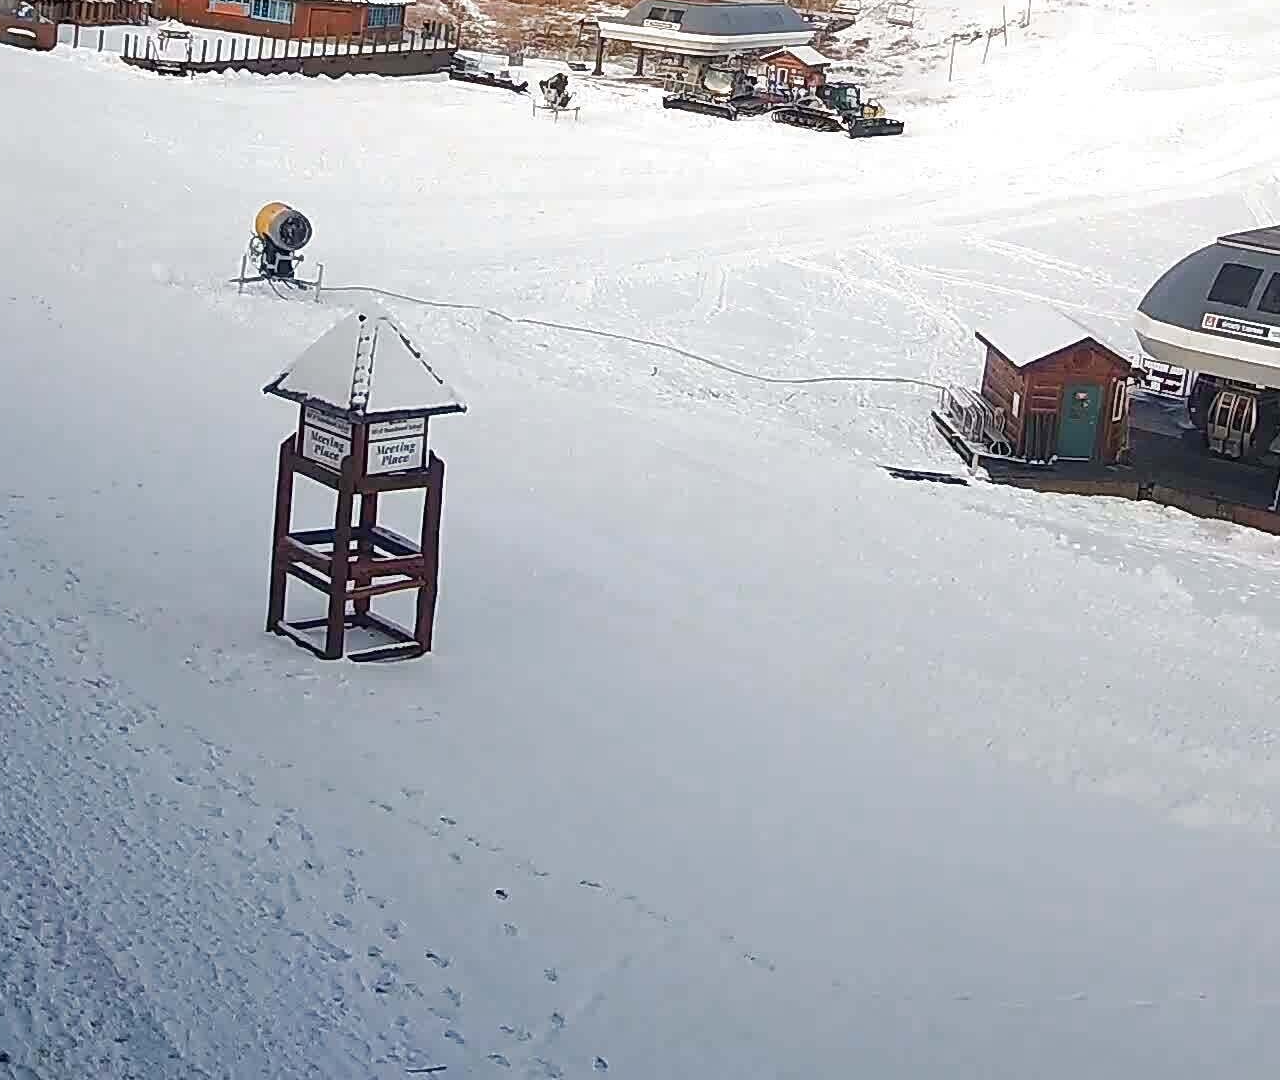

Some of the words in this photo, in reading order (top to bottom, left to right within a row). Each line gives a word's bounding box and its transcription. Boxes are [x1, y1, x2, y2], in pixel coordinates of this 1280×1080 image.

[314, 444, 340, 461] Place
[376, 441, 417, 456] Meeting
[381, 454, 410, 466] Place
